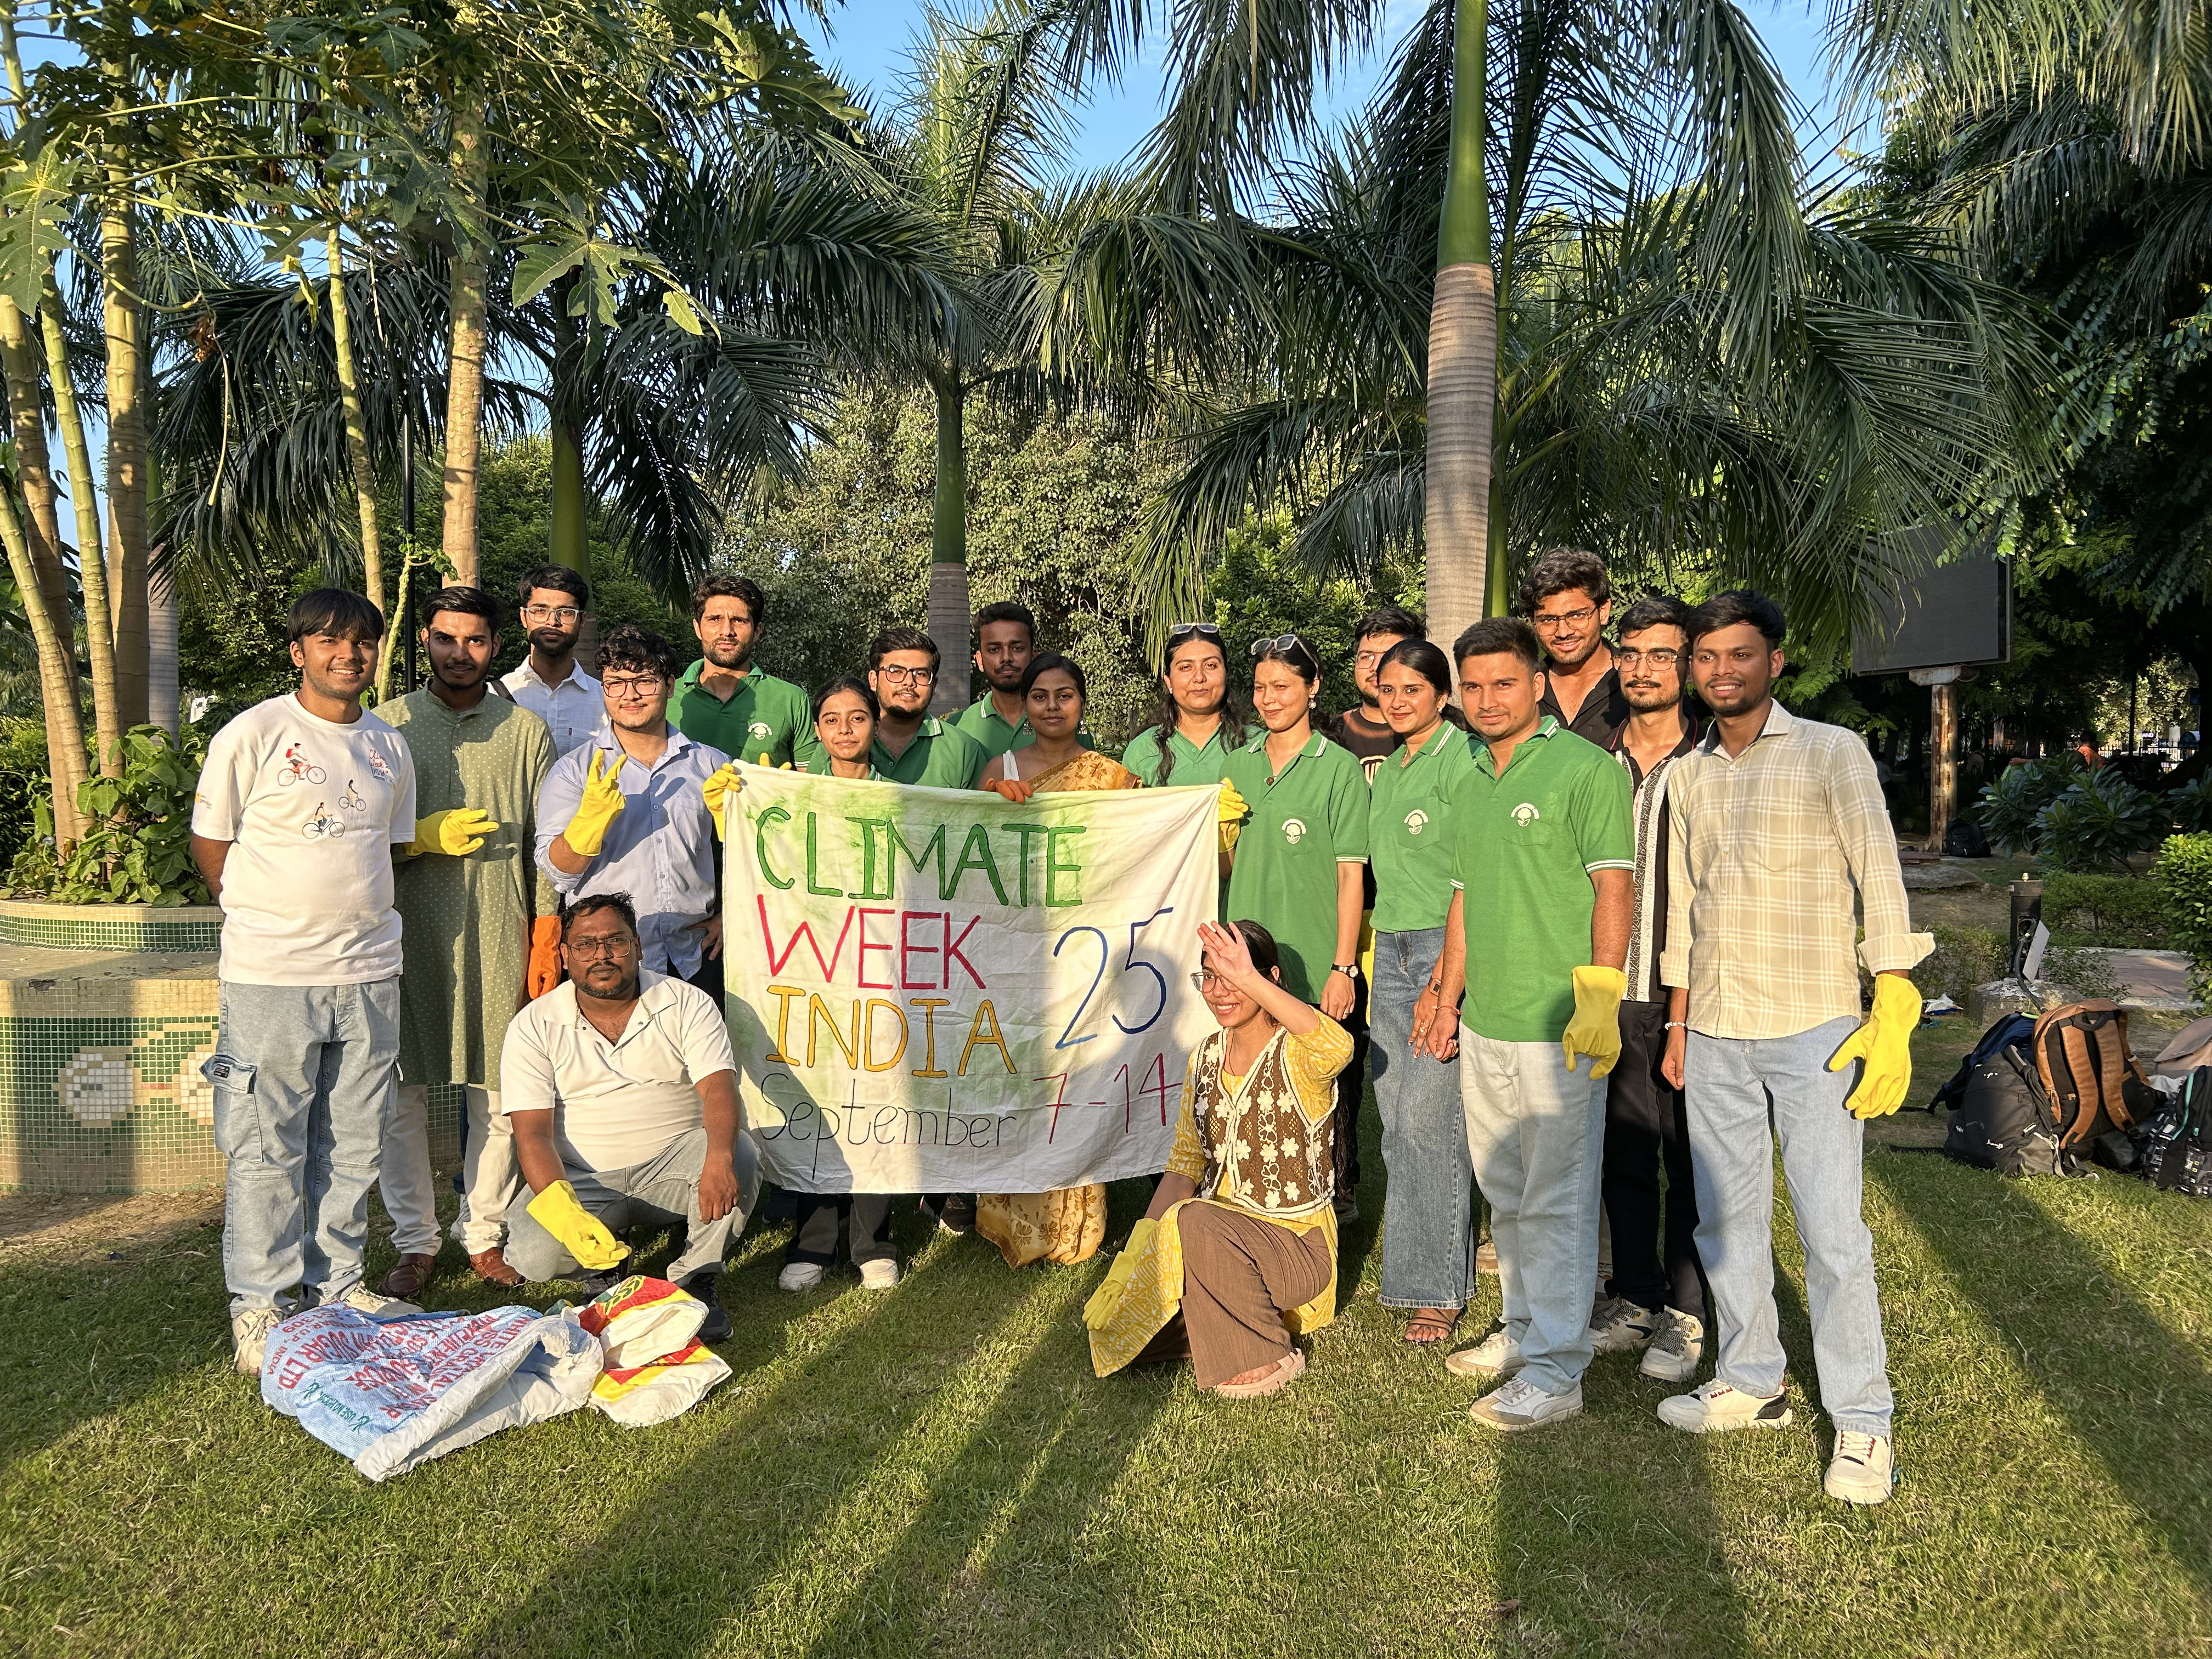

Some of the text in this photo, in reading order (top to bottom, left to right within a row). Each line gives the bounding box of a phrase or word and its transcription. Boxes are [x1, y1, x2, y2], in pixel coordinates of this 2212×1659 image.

[754, 806, 1087, 907] CLIMATE
[758, 894, 986, 990] WEEK
[1053, 907, 1173, 1049] 25
[765, 984, 1018, 1079] INDIA
[758, 1072, 1018, 1181] September
[267, 1346, 288, 1375] INDIA
